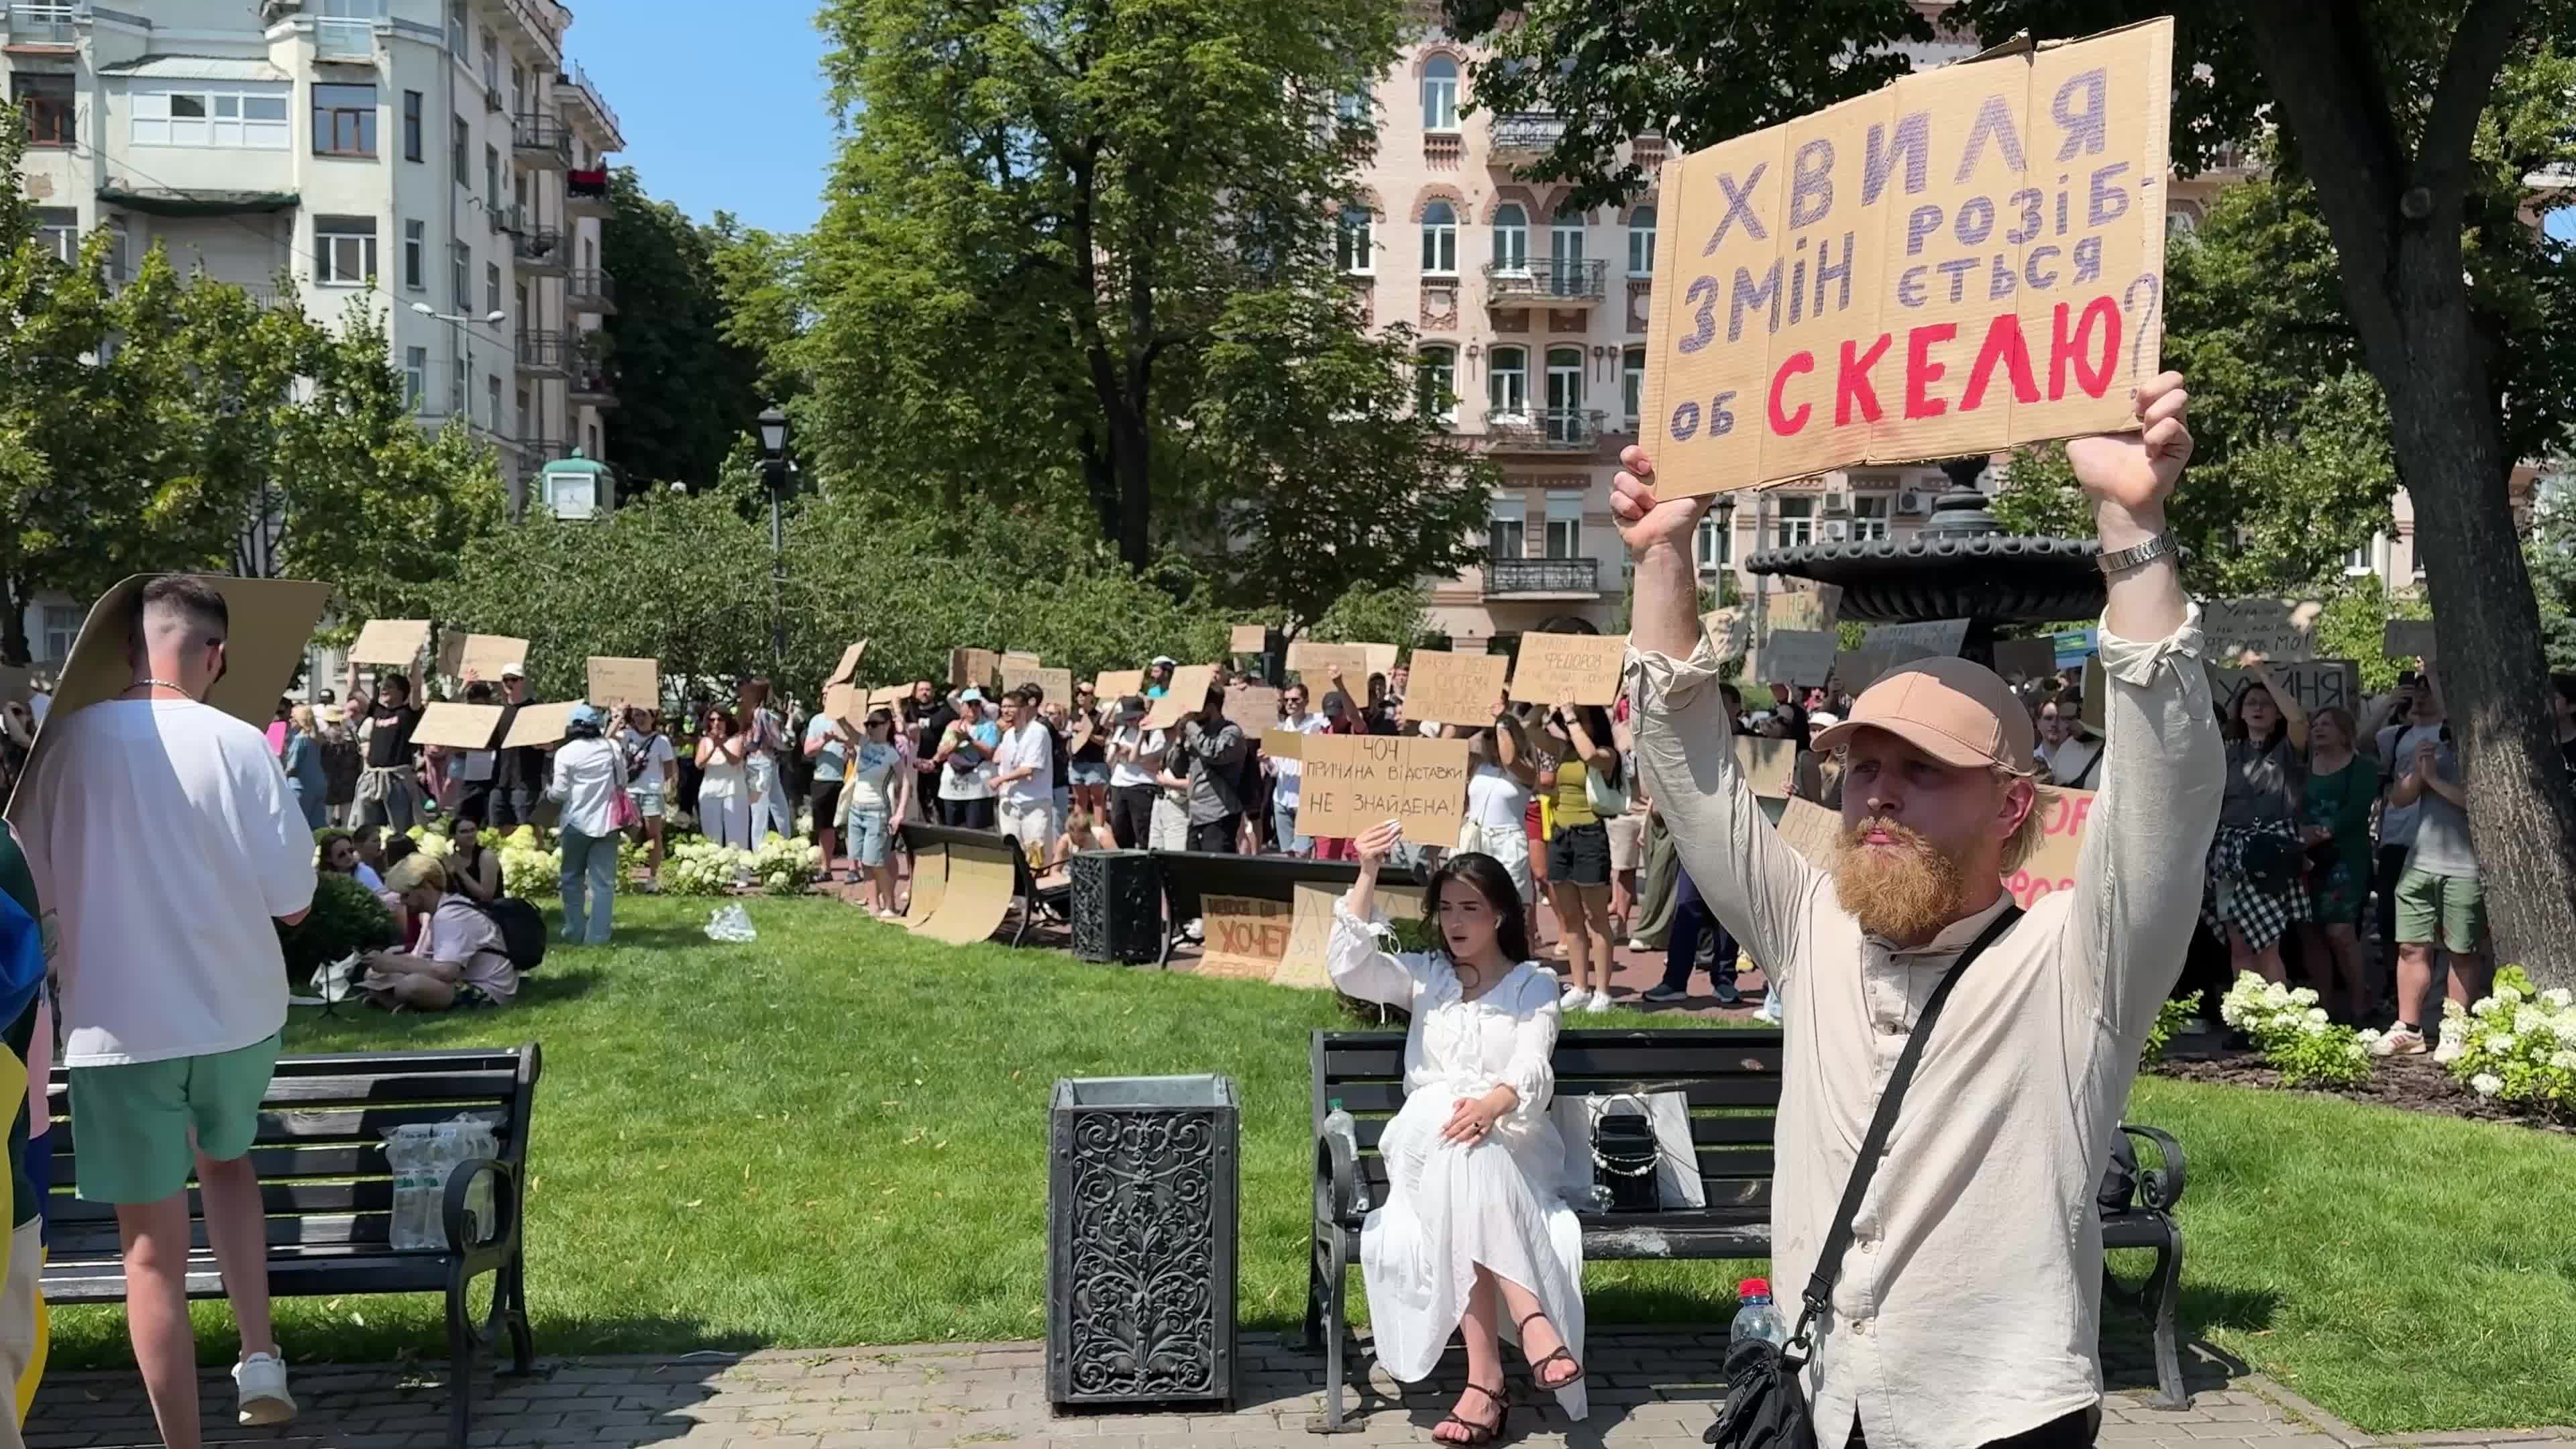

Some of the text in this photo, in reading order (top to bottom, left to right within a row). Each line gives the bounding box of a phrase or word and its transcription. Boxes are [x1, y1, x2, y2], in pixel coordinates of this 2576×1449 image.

[1702, 66, 2107, 258] ХВИЛЯ
[1897, 235, 2102, 308] ЄТЬСЯ
[1307, 761, 1375, 780] ПРИЧИНА
[1309, 792, 1456, 816] НЕ ЗНАЙДЕНА!
